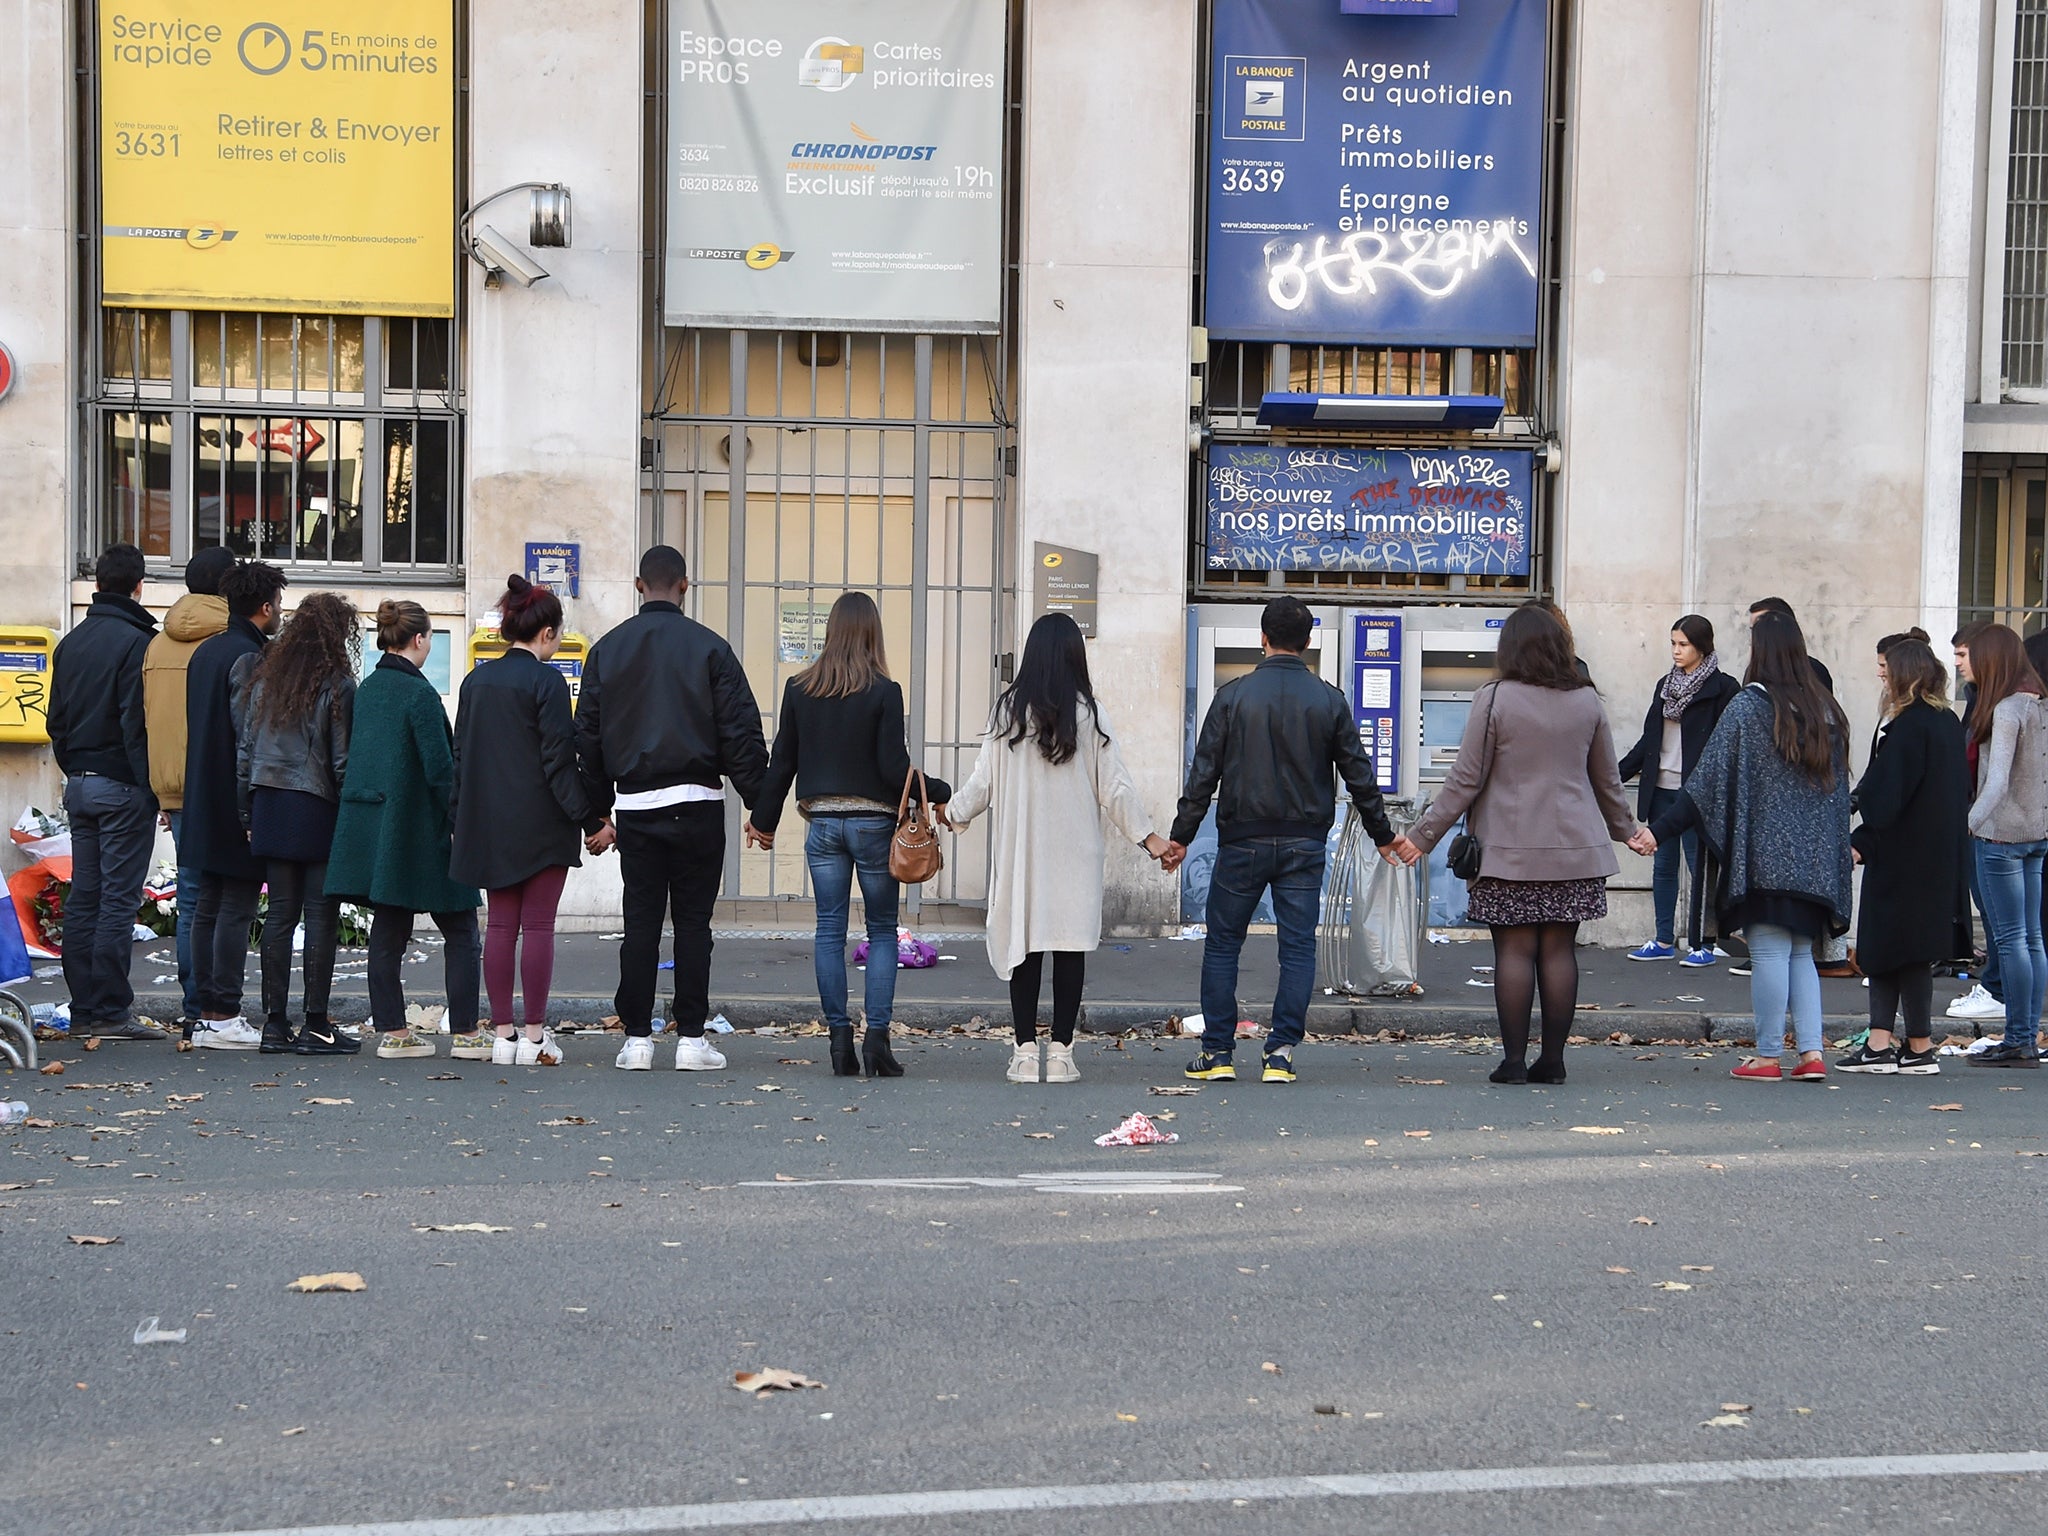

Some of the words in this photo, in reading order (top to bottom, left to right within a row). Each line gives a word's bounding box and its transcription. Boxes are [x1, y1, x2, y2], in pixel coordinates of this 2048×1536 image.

[113, 15, 222, 43] Service
[114, 42, 212, 68] rapide
[300, 30, 328, 71] 5
[331, 32, 350, 46] En
[357, 34, 409, 48] moins
[414, 35, 437, 49] de
[680, 31, 782, 59] Espace
[873, 41, 942, 61] Cartes
[332, 49, 438, 74] minutes
[680, 60, 750, 85] PROS
[1236, 66, 1250, 77] LA
[1251, 66, 1294, 78] BANQUE
[1343, 59, 1430, 83] Argent
[873, 67, 994, 89] prioritaires
[1342, 86, 1375, 103] au
[1386, 84, 1512, 107] quotidien
[114, 121, 135, 129] Votre
[137, 122, 166, 130] bureau
[218, 114, 302, 139] Retirer
[309, 117, 328, 139] &
[337, 118, 441, 147] Envoyer
[1241, 119, 1286, 131] POSTALE
[1342, 124, 1402, 144] Prêts
[218, 143, 273, 162] lettres
[279, 145, 297, 163] et
[302, 147, 346, 165] colis
[680, 149, 709, 161] 3634
[791, 143, 938, 161] CHRONOPOST
[1222, 158, 1241, 166] Votre
[1243, 159, 1272, 167] banque
[1341, 148, 1494, 171] immobiliers
[786, 161, 876, 172] INTERNATIONAL
[680, 177, 709, 191] 0820
[711, 178, 734, 192] 826
[736, 180, 759, 192] 826
[785, 173, 875, 196] Exclusif
[881, 175, 911, 188] dépôt
[913, 176, 949, 188] jusqu'à
[954, 165, 994, 187] 19h
[881, 187, 918, 200] départ
[922, 188, 932, 198] le
[935, 188, 954, 199] soir
[958, 190, 993, 199] même
[1340, 184, 1449, 213] Épargne
[128, 228, 143, 238] LA
[144, 228, 182, 239] POSTE
[1339, 213, 1362, 232] et
[1373, 213, 1529, 236] placements
[690, 250, 704, 258] LA
[706, 250, 741, 259] POSTE
[1351, 478, 1400, 508] THE
[1408, 486, 1509, 512] DRUNKS
[1220, 511, 1269, 531] nos
[1278, 508, 1345, 535] prêts
[1355, 510, 1518, 535] immobiliers
[542, 548, 572, 556] BANQUE
